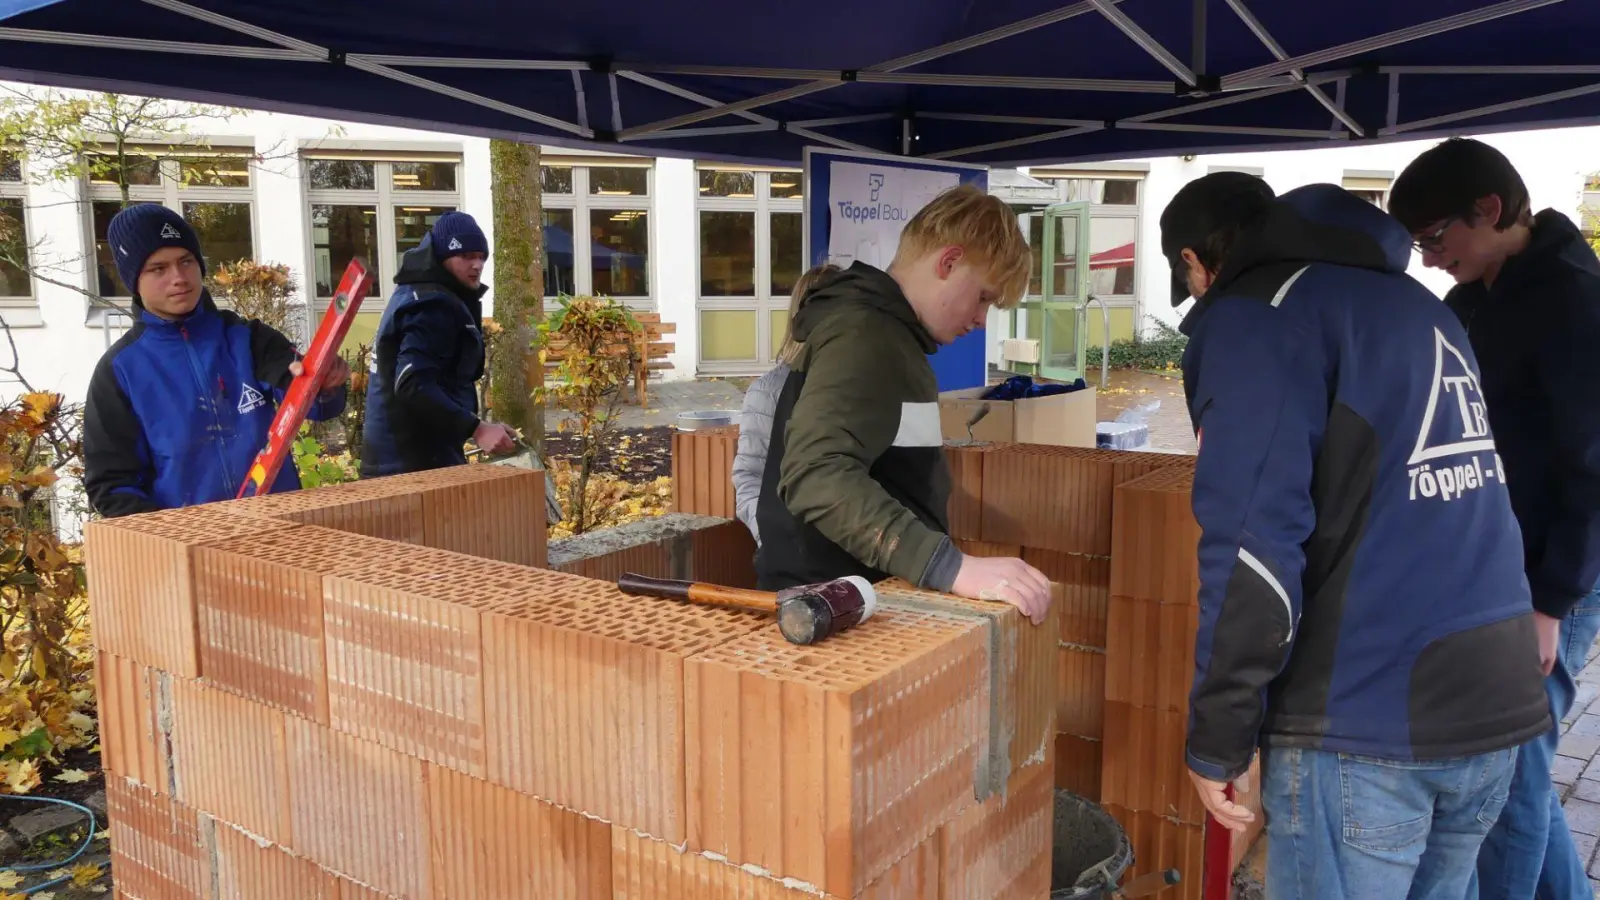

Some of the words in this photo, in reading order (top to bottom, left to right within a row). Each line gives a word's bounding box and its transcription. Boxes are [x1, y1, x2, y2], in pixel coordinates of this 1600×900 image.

[838, 201, 881, 224] Töppel
[882, 204, 908, 221] Bau
[1408, 456, 1483, 502] Töppel
